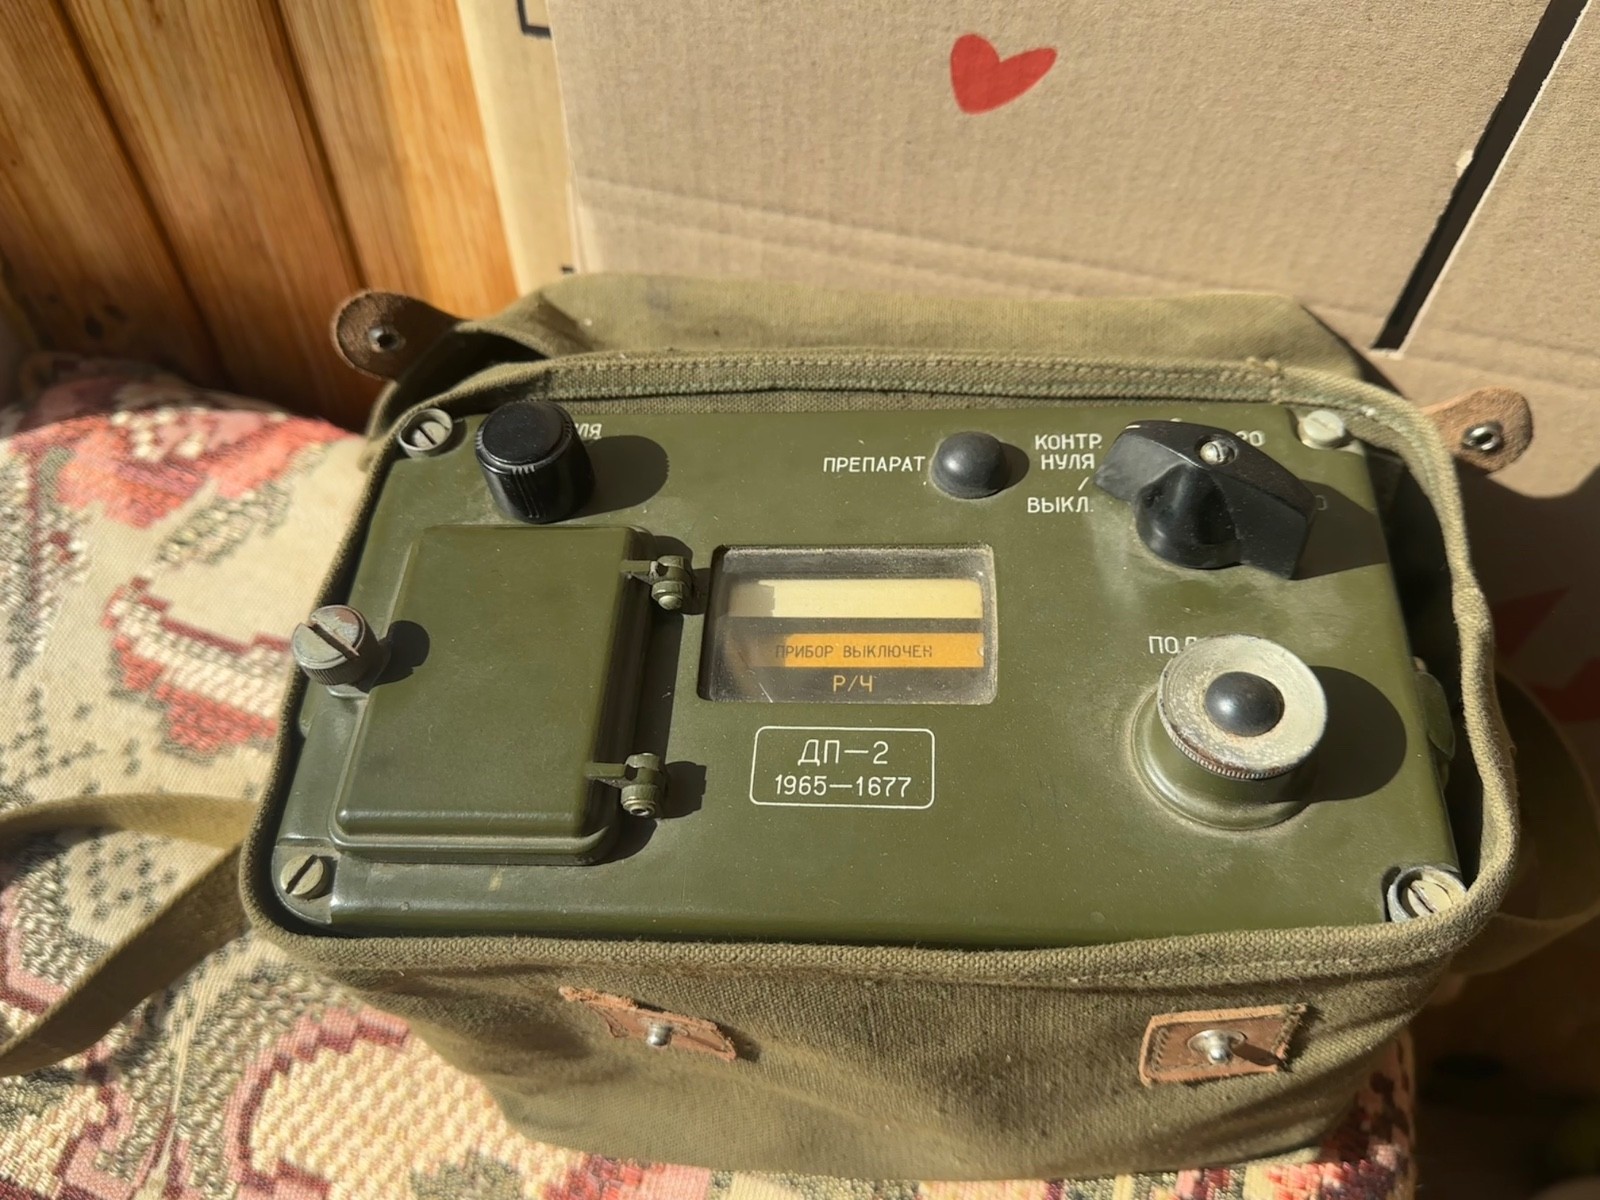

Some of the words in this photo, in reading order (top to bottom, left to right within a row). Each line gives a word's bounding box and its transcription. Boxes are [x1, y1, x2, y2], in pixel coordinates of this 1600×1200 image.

[823, 455, 927, 473] ПРЕПАРАТ
[1041, 453, 1096, 471] НУЛЯ
[1027, 496, 1094, 514] ВЫКЛ.
[776, 644, 834, 659] ПРИБОР
[843, 644, 933, 659] ВЫКЛЮЧЕН
[833, 674, 874, 693] Р/Ч
